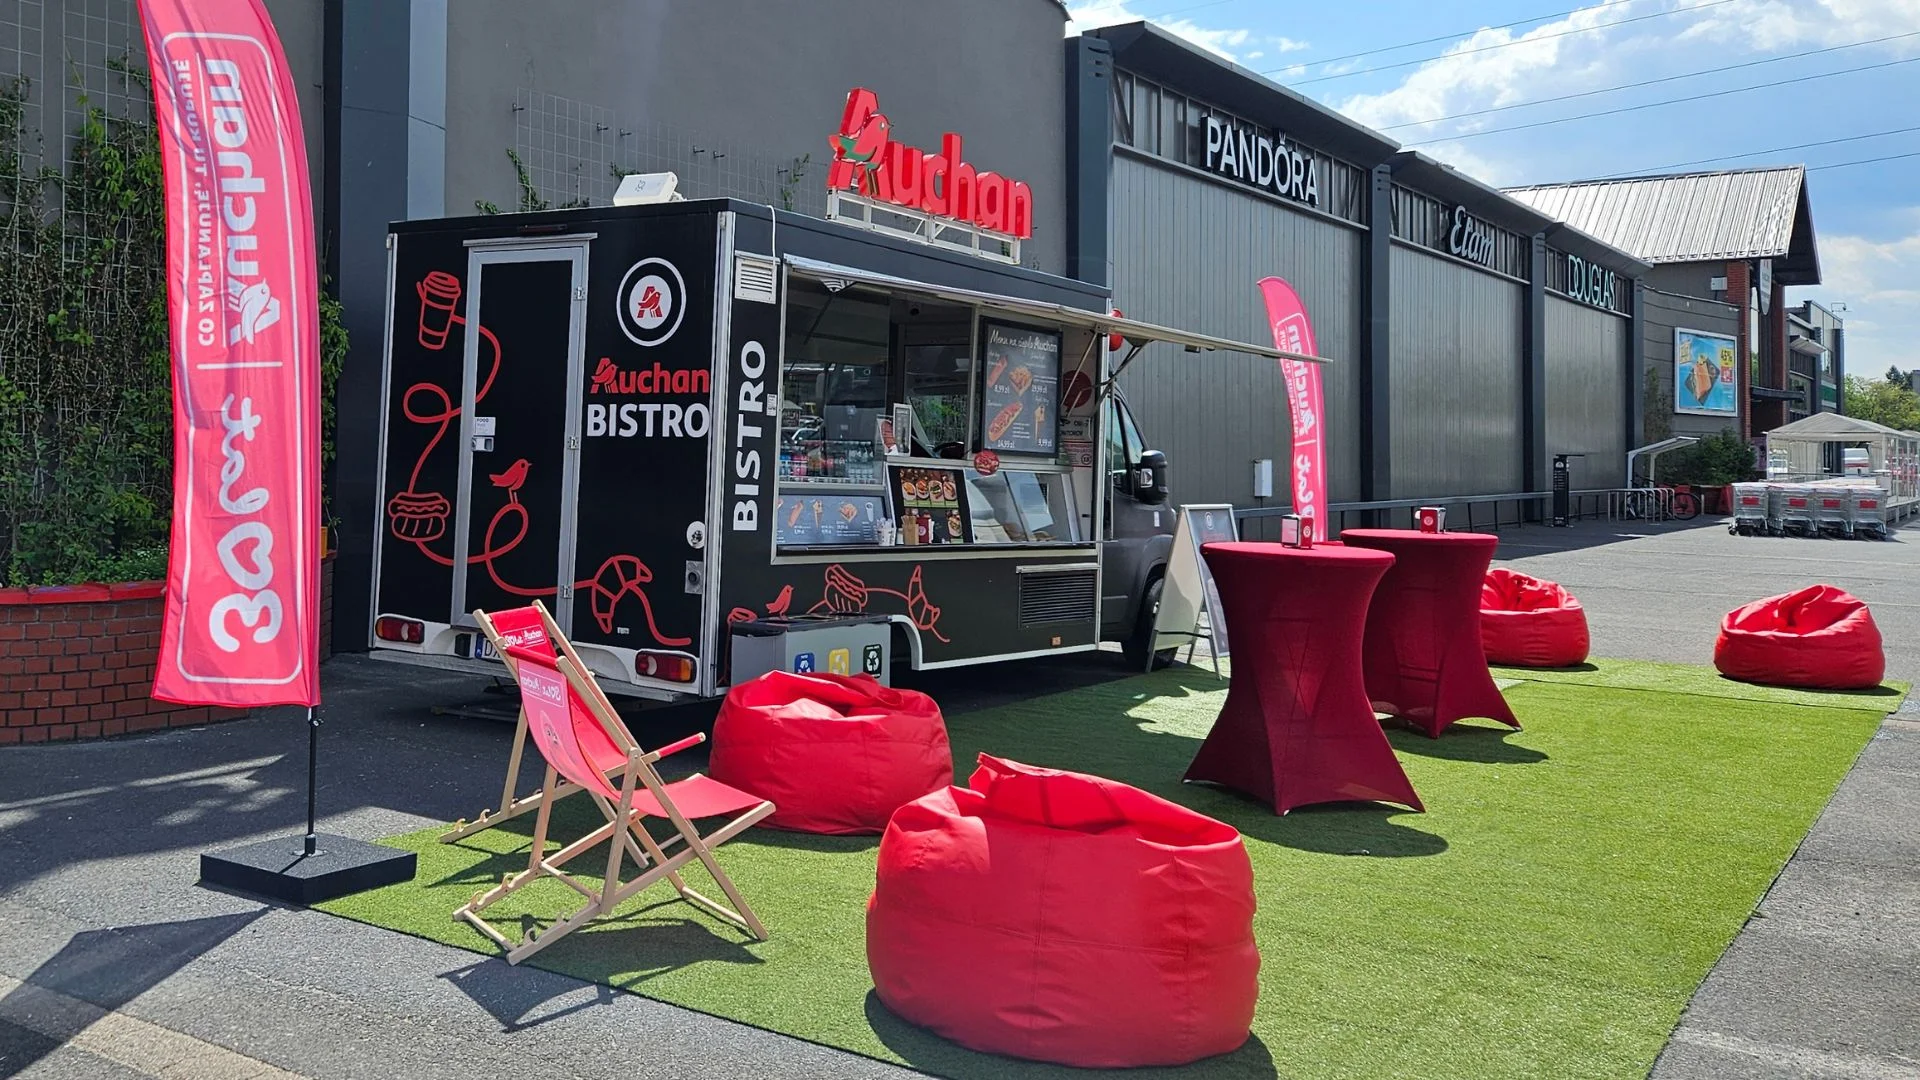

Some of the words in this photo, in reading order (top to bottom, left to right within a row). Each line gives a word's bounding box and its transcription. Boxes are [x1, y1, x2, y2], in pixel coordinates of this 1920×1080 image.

[827, 87, 1033, 240] Auchan
[1204, 115, 1319, 205] PANDORA
[1450, 205, 1495, 266] Etam
[1568, 254, 1616, 312] DOUGLAS
[590, 358, 710, 394] Auchan
[586, 403, 710, 438] BISTRO
[733, 340, 766, 532] BISTRO
